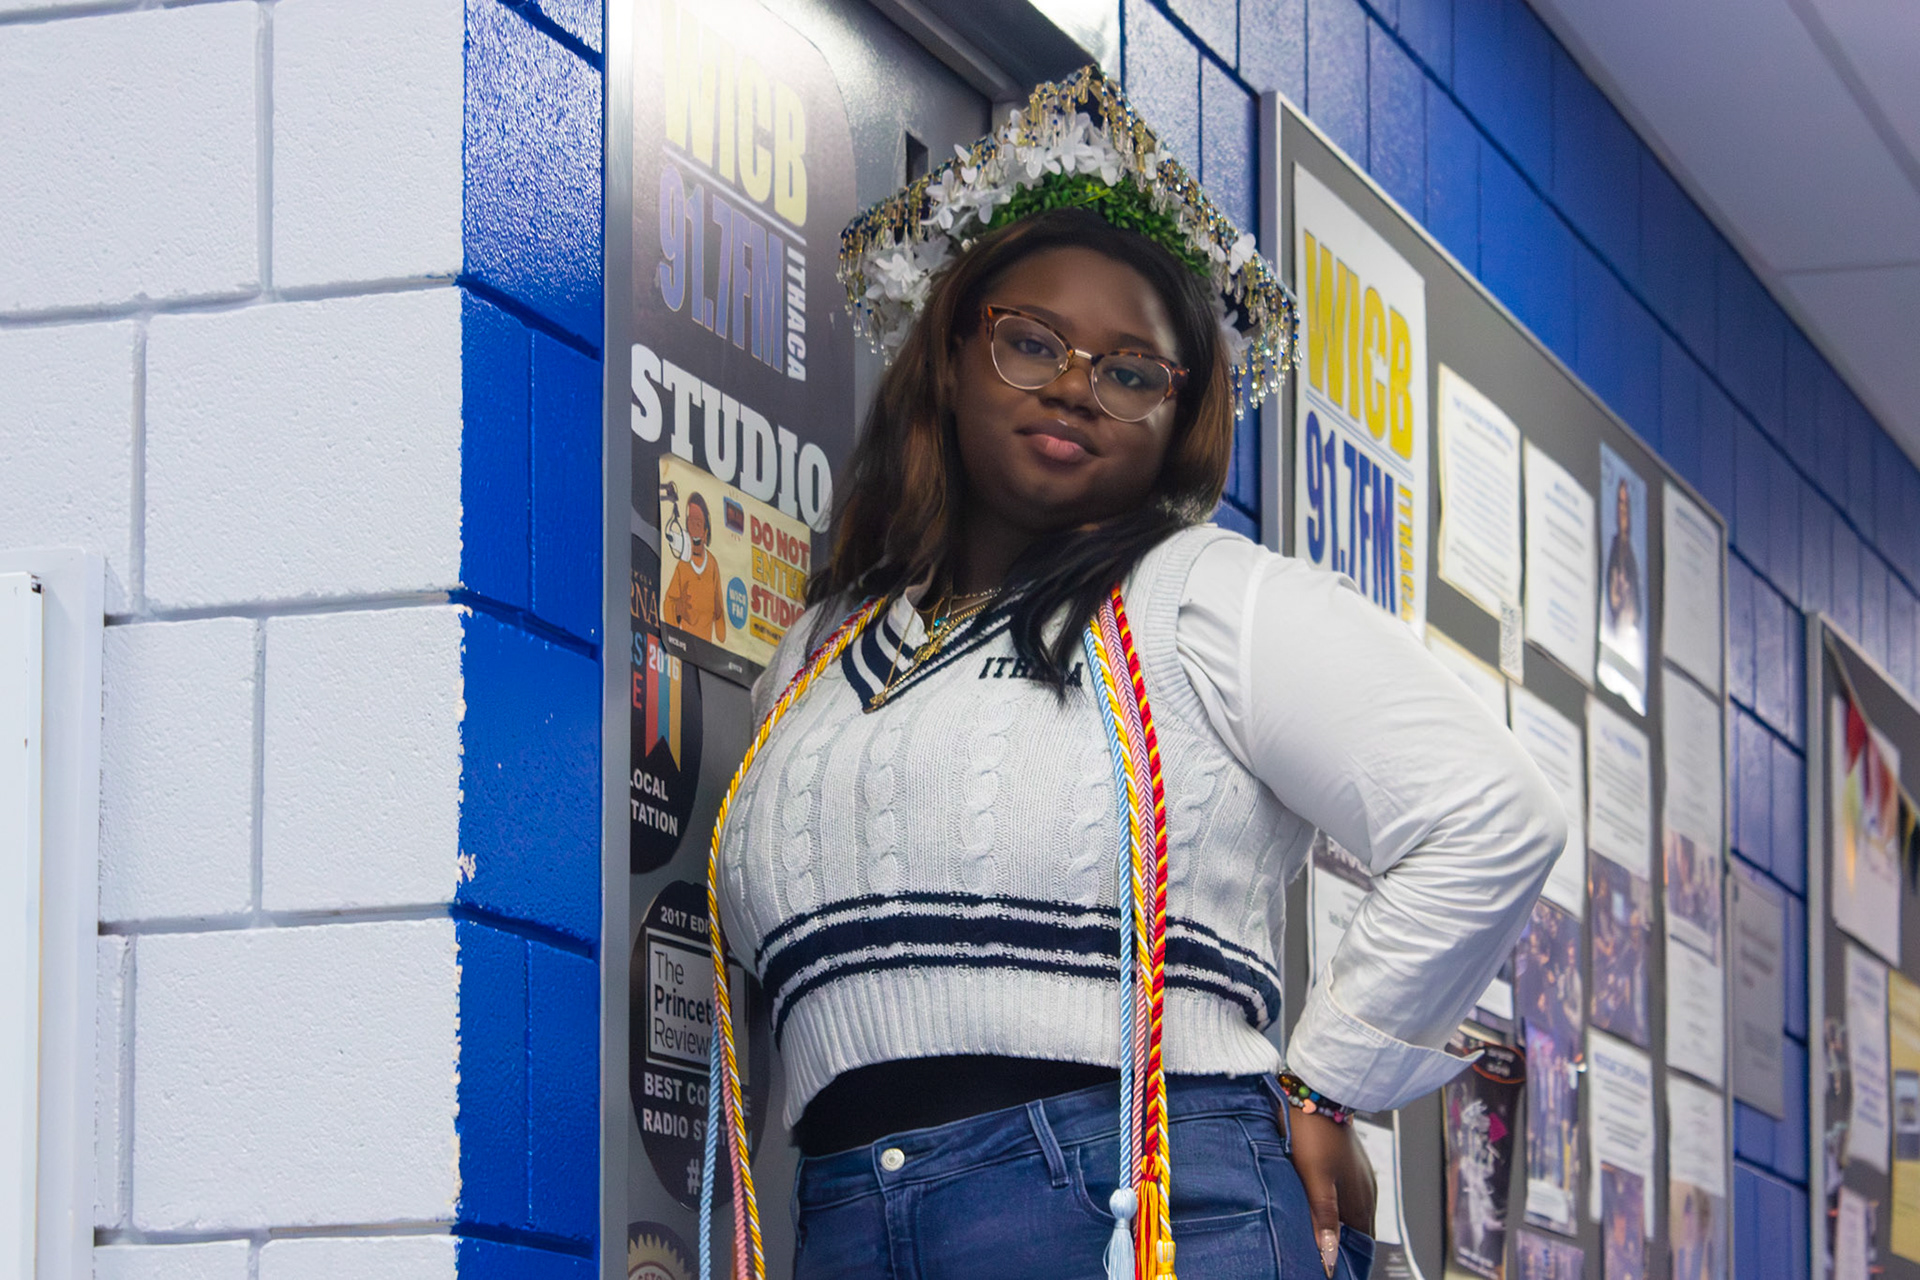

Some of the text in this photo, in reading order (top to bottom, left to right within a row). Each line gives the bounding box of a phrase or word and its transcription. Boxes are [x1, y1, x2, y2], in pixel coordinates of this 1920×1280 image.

[660, 0, 808, 227] WICB
[659, 165, 783, 374] 91.7FM
[787, 246, 807, 381] ITHACA
[1304, 228, 1413, 462] WICB
[631, 344, 833, 534] STUDIO
[1306, 410, 1396, 616] 91.7FM
[750, 514, 810, 574] DO NOT
[751, 545, 806, 606] ENTER
[648, 643, 682, 681] 2016
[630, 768, 669, 802] OCAL
[660, 906, 687, 929] 2017
[655, 951, 684, 985] The
[654, 983, 713, 1026] Princet
[654, 1017, 711, 1058] Review
[644, 1071, 682, 1102] BEST
[643, 1107, 688, 1139] RADIO
